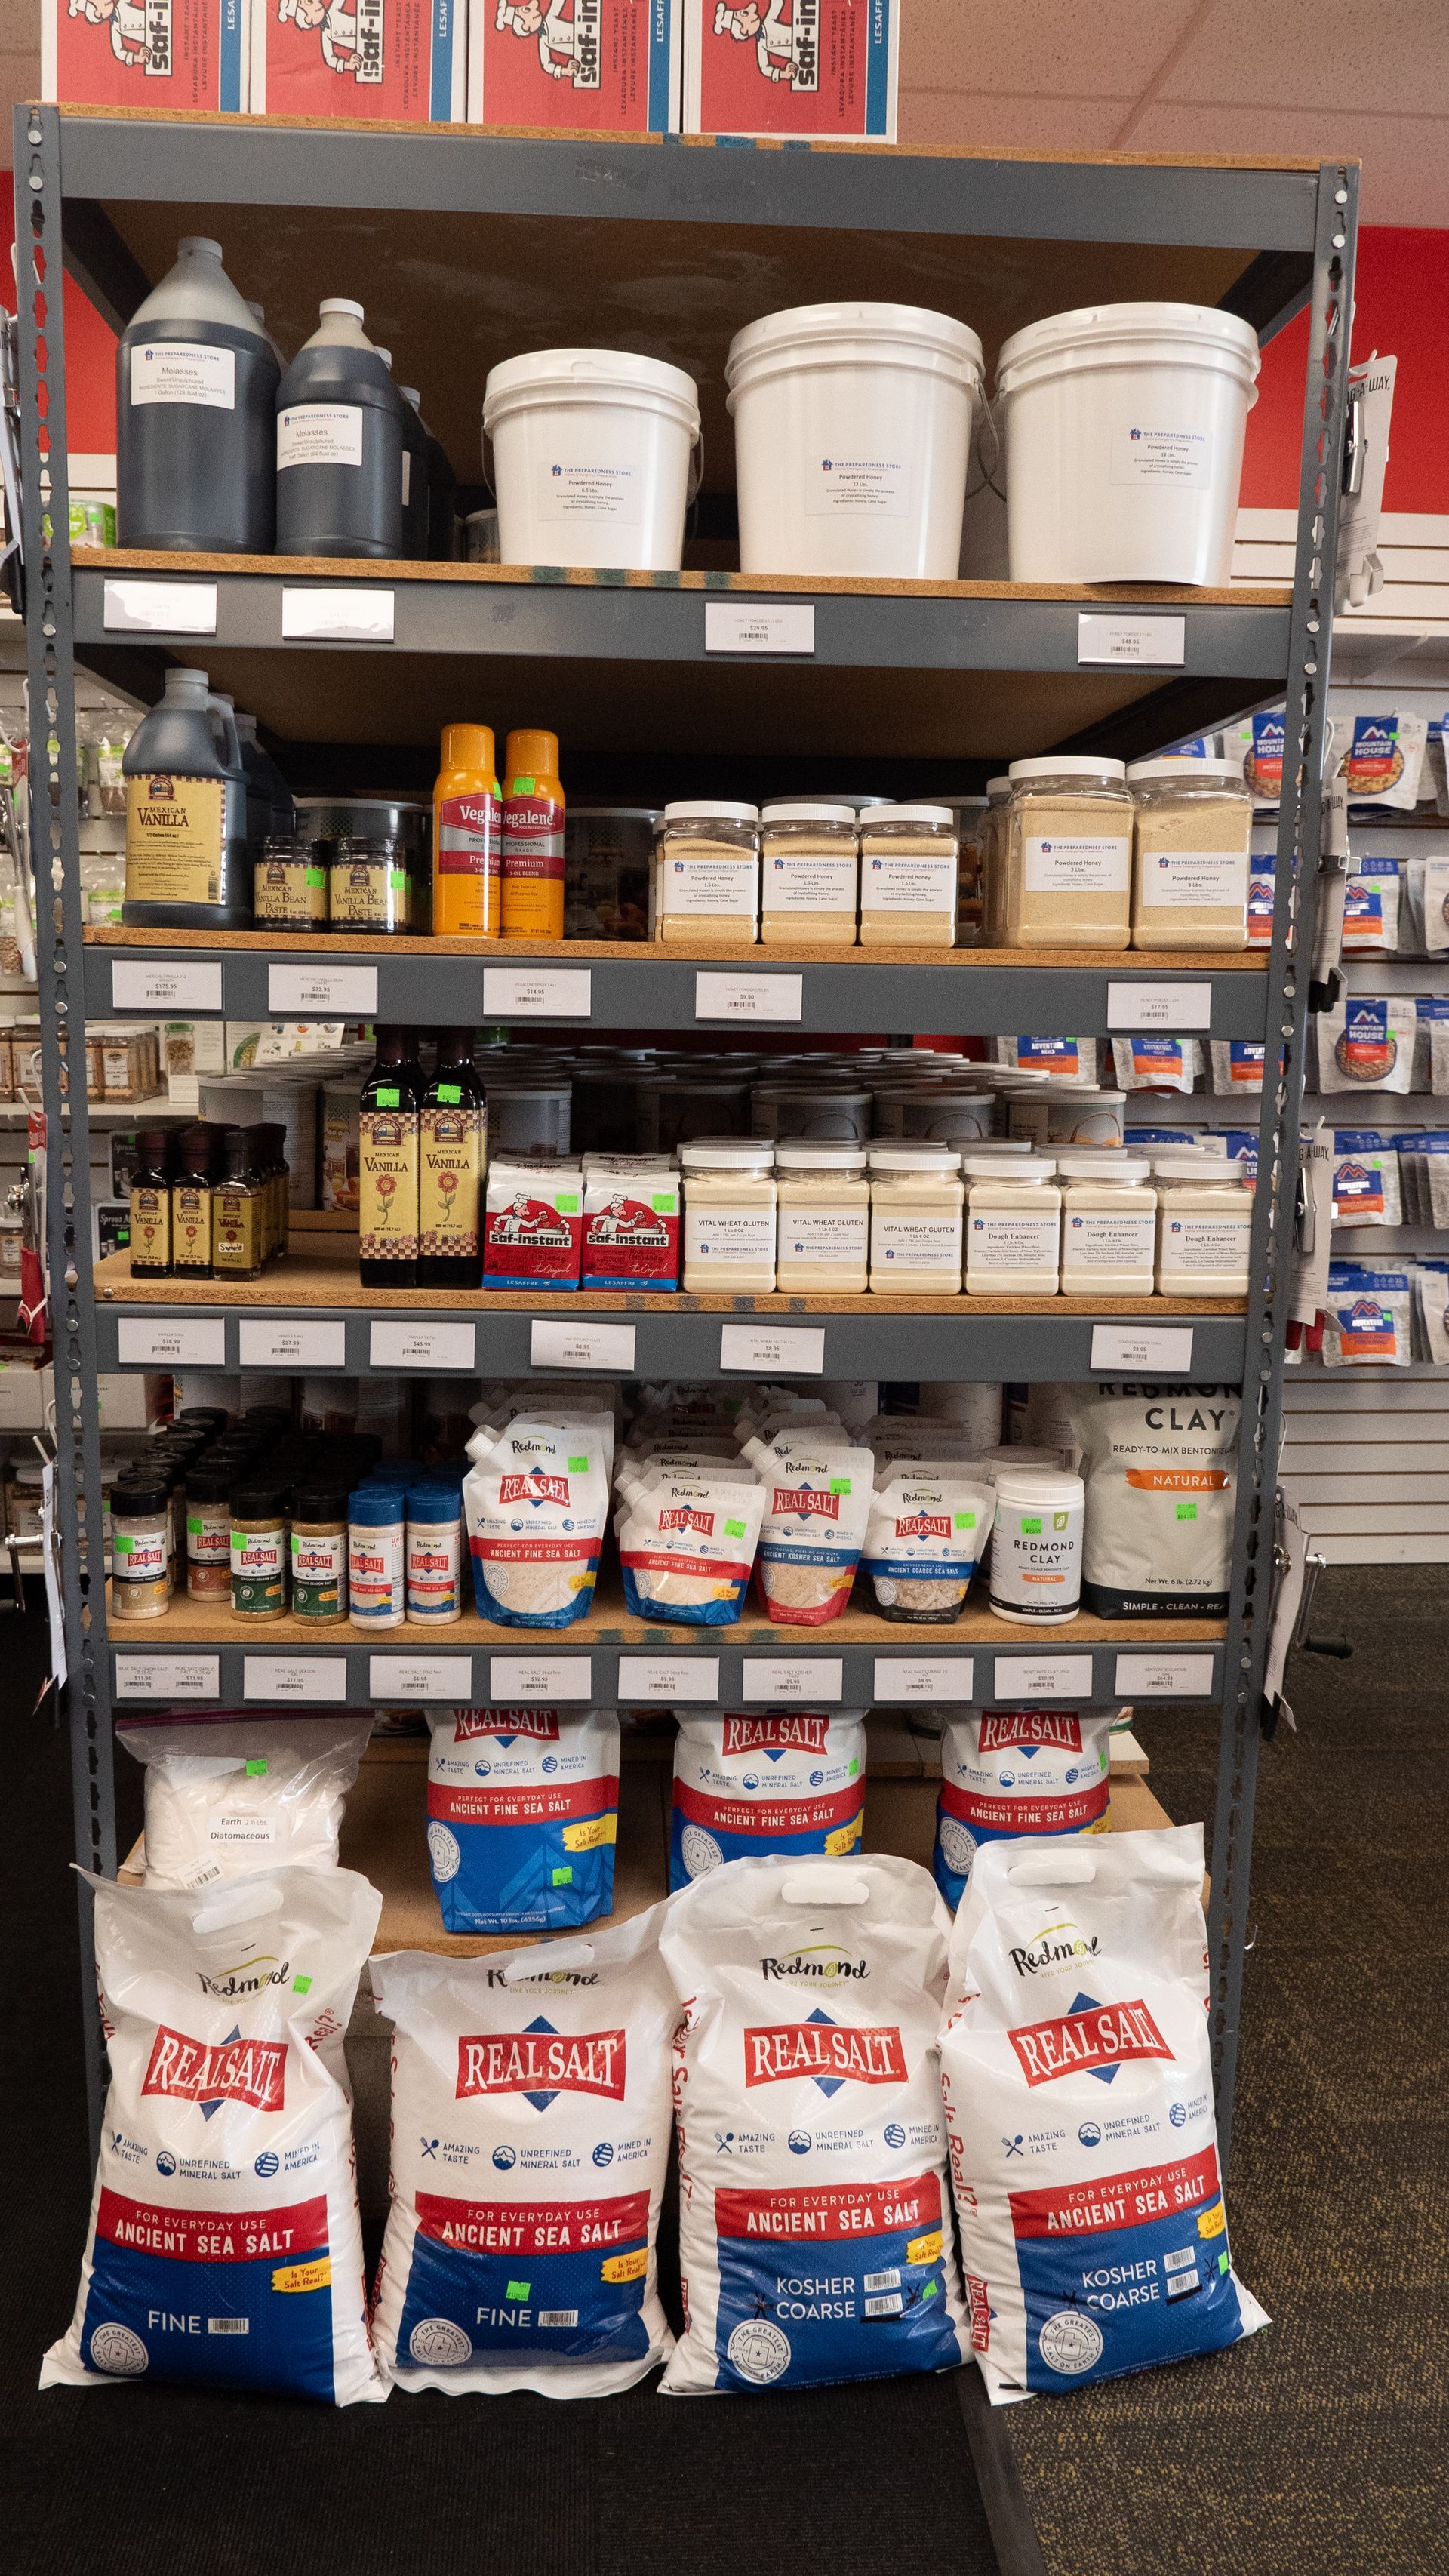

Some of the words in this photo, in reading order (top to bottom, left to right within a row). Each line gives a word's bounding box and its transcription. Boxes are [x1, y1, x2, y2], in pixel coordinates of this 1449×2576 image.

[162, 367, 198, 376] Molasses
[295, 428, 328, 439] Molasses
[1355, 746, 1392, 756] HOUSE
[137, 808, 189, 827] VANILLA
[502, 809, 554, 828] Vegalene
[506, 860, 544, 868] Premium
[334, 894, 365, 905] VANILLA
[348, 905, 372, 916] PASTE
[364, 1157, 408, 1173] VANILLA
[426, 1153, 470, 1170] VANILLA
[134, 1214, 163, 1226] VANILLA
[490, 1233, 571, 1247] saf-instant
[587, 1233, 667, 1247] saf-instant
[1145, 1407, 1226, 1431] CLAY
[512, 1440, 557, 1454] Redmond
[1113, 1445, 1179, 1454] READY-TO-MIX
[785, 1462, 829, 1474] Redmond
[1153, 1475, 1214, 1487] NATURAL
[776, 1491, 805, 1513] REAL
[805, 1492, 836, 1516] SALT
[903, 1493, 943, 1503] Redmond
[898, 1518, 923, 1535] REAL
[923, 1519, 950, 1537] SALT
[1014, 1539, 1075, 1551] REDMOND
[491, 1549, 521, 1559] ANCIENT
[525, 1549, 543, 1559] FINE
[546, 1549, 561, 1558] SEA
[564, 1549, 580, 1558] SALT
[1030, 1554, 1062, 1564] CLAY
[1123, 1602, 1158, 1611] SIMPLE
[1166, 1602, 1198, 1611] CLEAN
[727, 1718, 776, 1751] REAL
[779, 1718, 824, 1749] SALT
[983, 1716, 1029, 1748] REAL
[1032, 1715, 1074, 1746] SALT
[450, 1802, 488, 1815] ANCIENT
[494, 1802, 518, 1814] FINE
[524, 1802, 543, 1813] SEA
[548, 1799, 571, 1811] SALT
[221, 1817, 242, 1826] Earth
[211, 1832, 269, 1840] Diatomaceous
[759, 1956, 871, 1982] Redmond
[1015, 2021, 1101, 2077] REAL
[1097, 2008, 1164, 2056] SALT
[752, 2030, 832, 2078] REAL
[831, 2033, 894, 2076] SALT
[149, 2035, 223, 2091] REAL
[218, 2047, 281, 2103] SALT
[465, 2041, 543, 2090] REAL
[548, 2039, 618, 2088] SALT
[443, 2143, 480, 2155] AMAZING
[618, 2140, 641, 2151] MINED
[643, 2138, 651, 2147] IN
[443, 2154, 469, 2165] TASTE
[521, 2149, 571, 2158] UNREFINED
[617, 2150, 648, 2162] AMERICA
[520, 2159, 558, 2168] MINERAL
[562, 2159, 580, 2168] SALT
[1069, 2191, 1095, 2203] FOR
[1100, 2175, 1162, 2198] EVERYDAY
[1168, 2168, 1186, 2181] USE
[770, 2197, 797, 2208] FOR
[803, 2193, 872, 2207] EVERYDAY
[878, 2189, 900, 2200] USE
[1048, 2199, 1126, 2230] ANCIENT
[1135, 2192, 1168, 2215] SEA
[1175, 2175, 1205, 2205] SALT
[136, 2210, 158, 2224] FOR
[165, 2217, 233, 2231] EVERYDAY
[240, 2219, 266, 2230] USE
[468, 2209, 494, 2221] FOR
[500, 2210, 571, 2222] EVERYDAY
[577, 2208, 600, 2220] USE
[747, 2211, 828, 2232] ANCIENT
[838, 2208, 875, 2230] SEA
[884, 2199, 919, 2225] SALT
[115, 2219, 187, 2253] ANCIENT
[198, 2235, 235, 2255] SEA
[246, 2229, 294, 2253] SALT
[441, 2221, 525, 2246] ANCIENT
[534, 2227, 571, 2246] SEA
[580, 2219, 622, 2243] SALT
[284, 2279, 300, 2289] Salt
[303, 2273, 325, 2288] Real?
[291, 2270, 298, 2279] Is
[300, 2267, 318, 2277] Your
[1081, 2260, 1157, 2288] KOSHER
[777, 2277, 855, 2295] KOSHER
[1085, 2285, 1160, 2311] COARSE
[476, 2307, 532, 2327] FINE
[776, 2301, 855, 2320] COARSE
[148, 2310, 202, 2334] FINE
